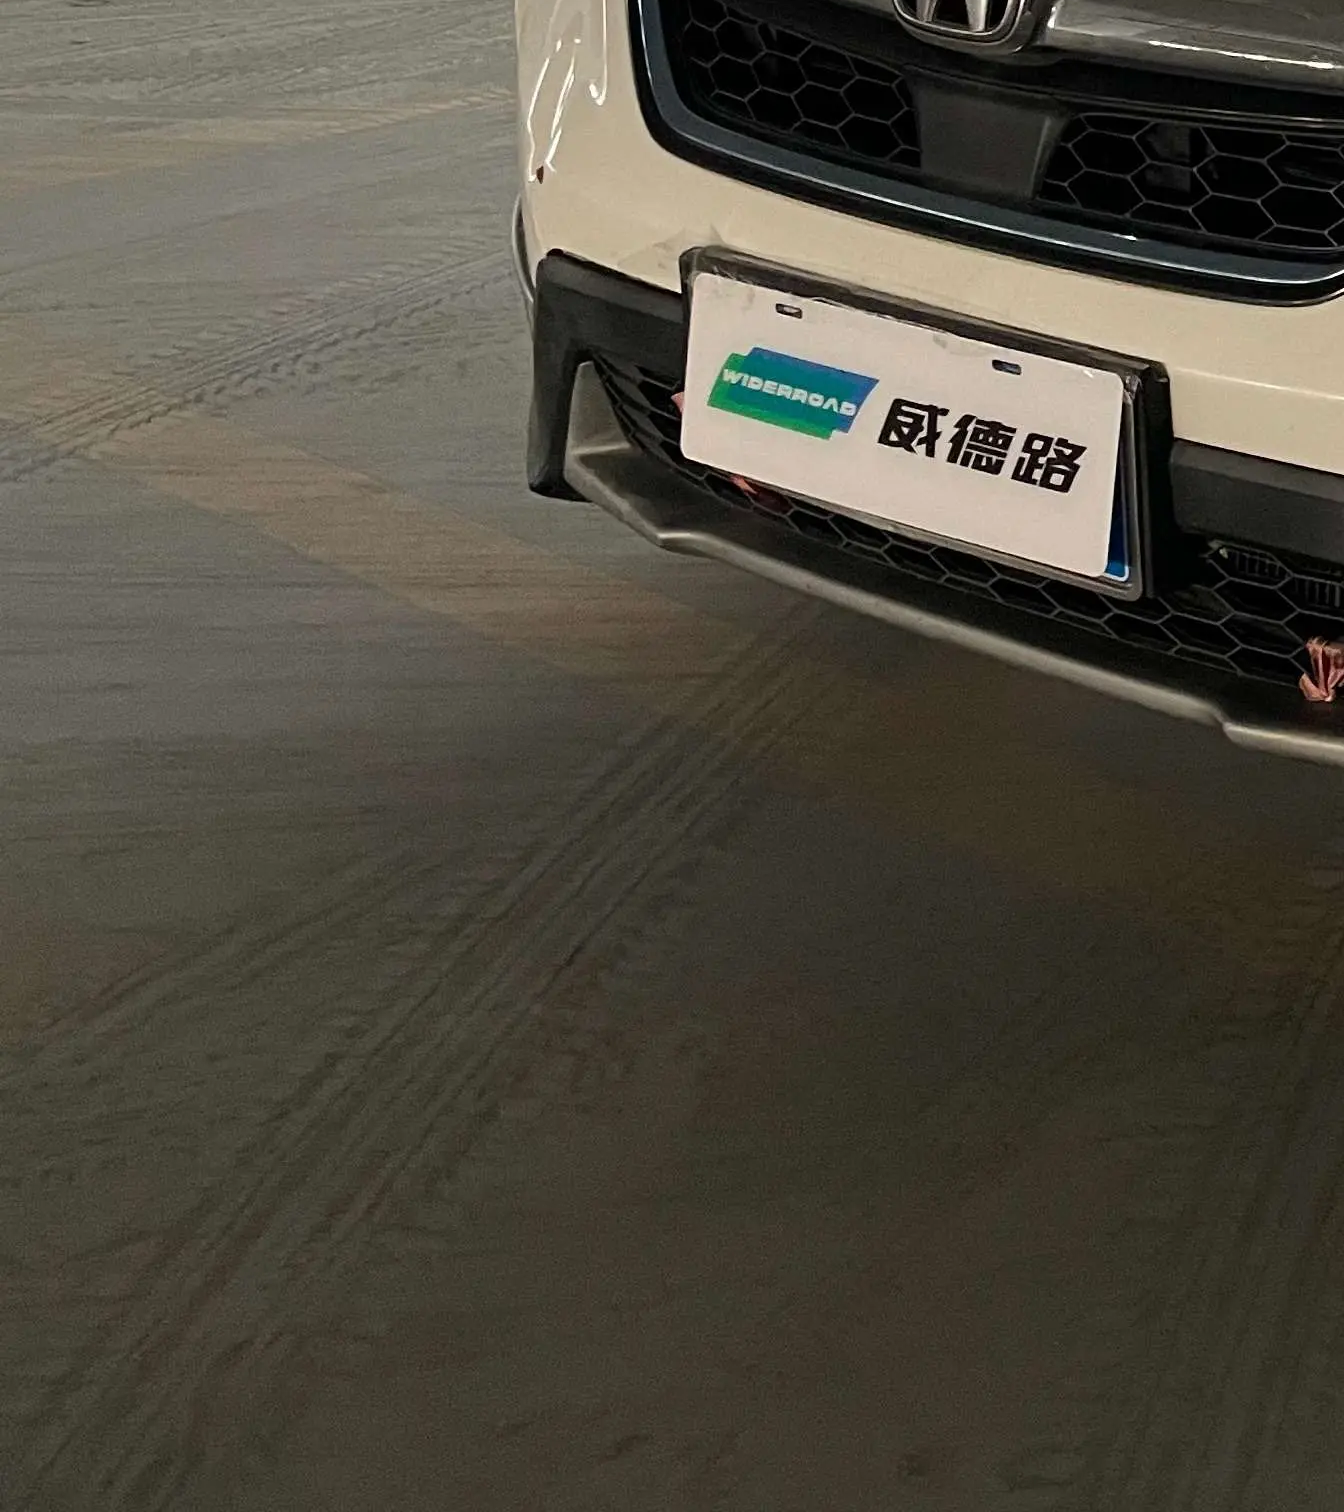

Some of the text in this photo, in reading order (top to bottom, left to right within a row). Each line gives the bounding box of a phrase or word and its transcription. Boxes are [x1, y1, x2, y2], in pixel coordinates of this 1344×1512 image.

[722, 368, 857, 416] WIDERROAD
[877, 398, 1087, 493] 威德路
